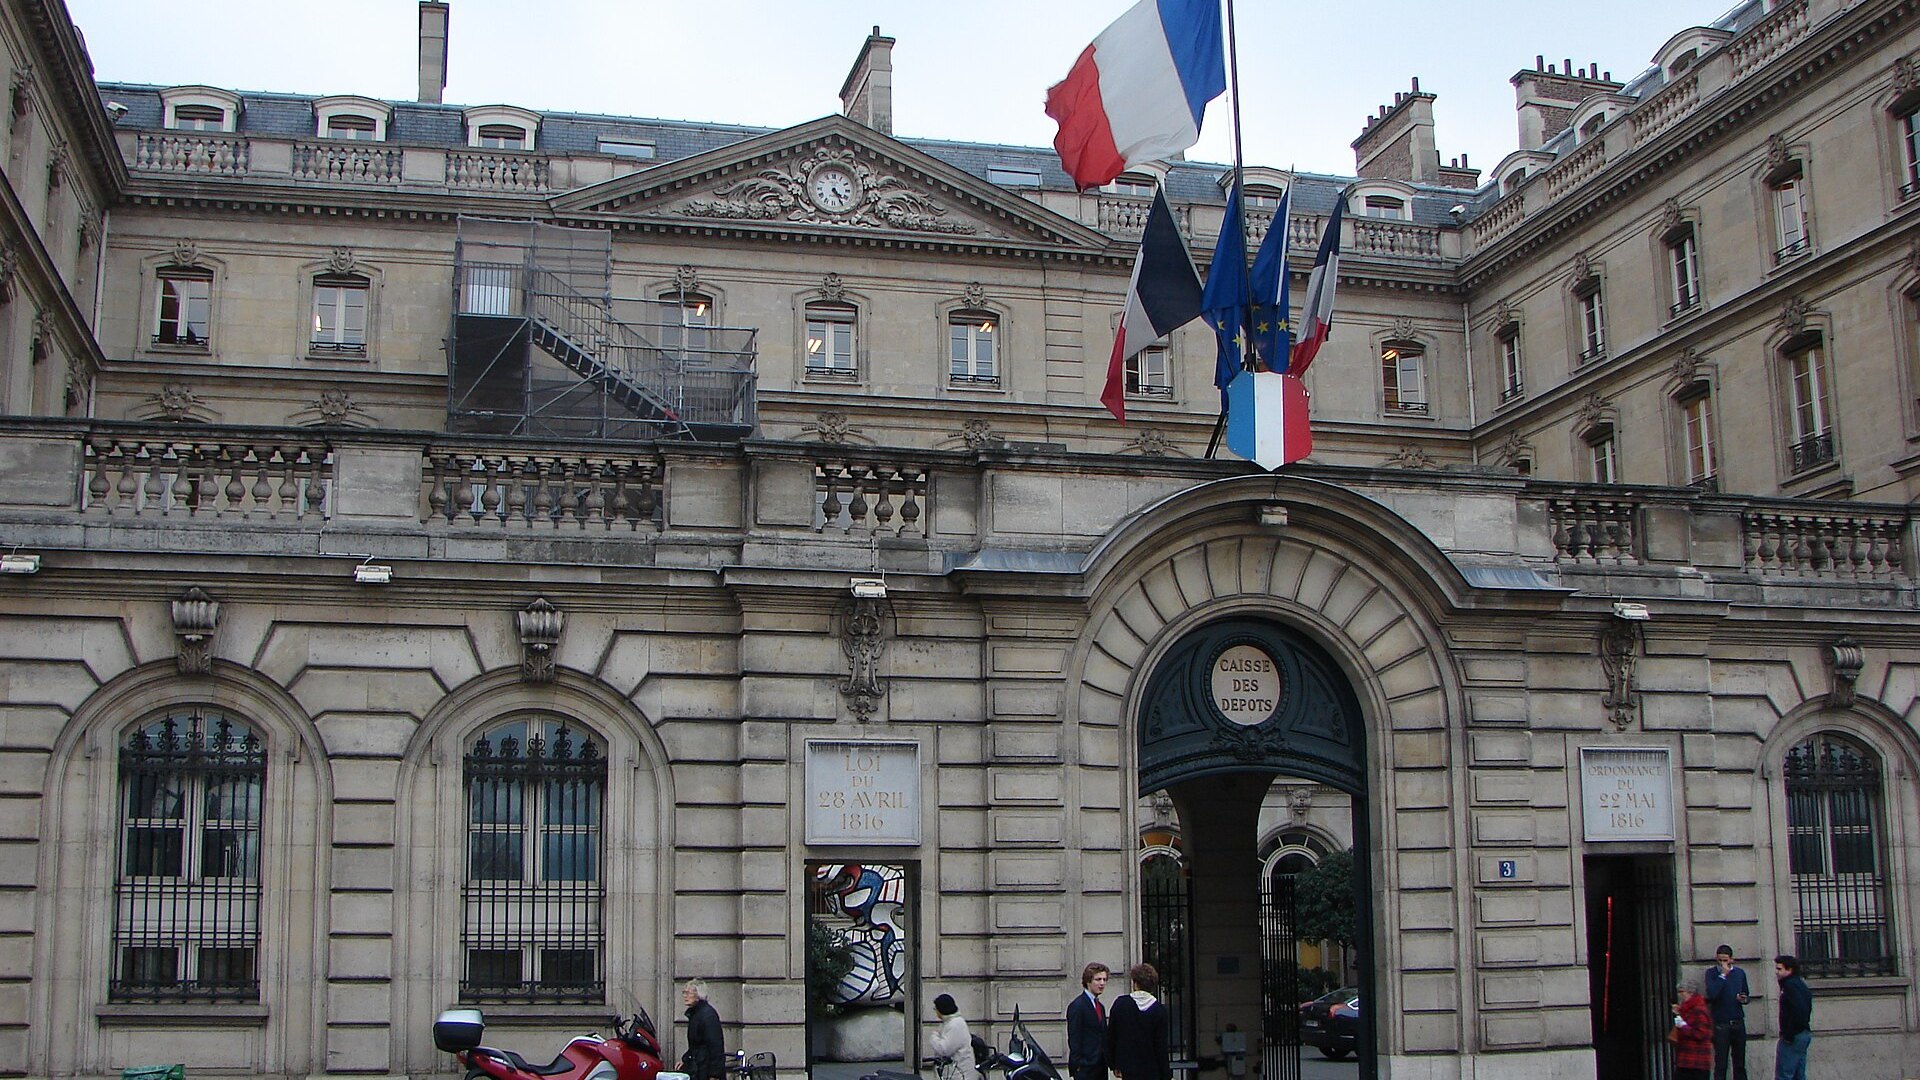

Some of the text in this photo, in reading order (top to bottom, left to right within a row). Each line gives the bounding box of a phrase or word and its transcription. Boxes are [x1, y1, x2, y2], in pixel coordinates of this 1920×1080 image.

[1220, 659, 1271, 673] CAISSE
[1232, 679, 1259, 692] DES
[1221, 698, 1272, 712] DEPOTS
[845, 754, 881, 772] LOI
[1588, 765, 1665, 777] ORDONNANCE
[852, 775, 874, 787] DU
[1617, 779, 1635, 790] DU
[819, 791, 909, 809] 28 AVRIL
[1599, 792, 1656, 809] 22 MAI
[842, 813, 884, 830] 1816
[1611, 812, 1645, 828] 1816
[1503, 862, 1511, 877] 3
